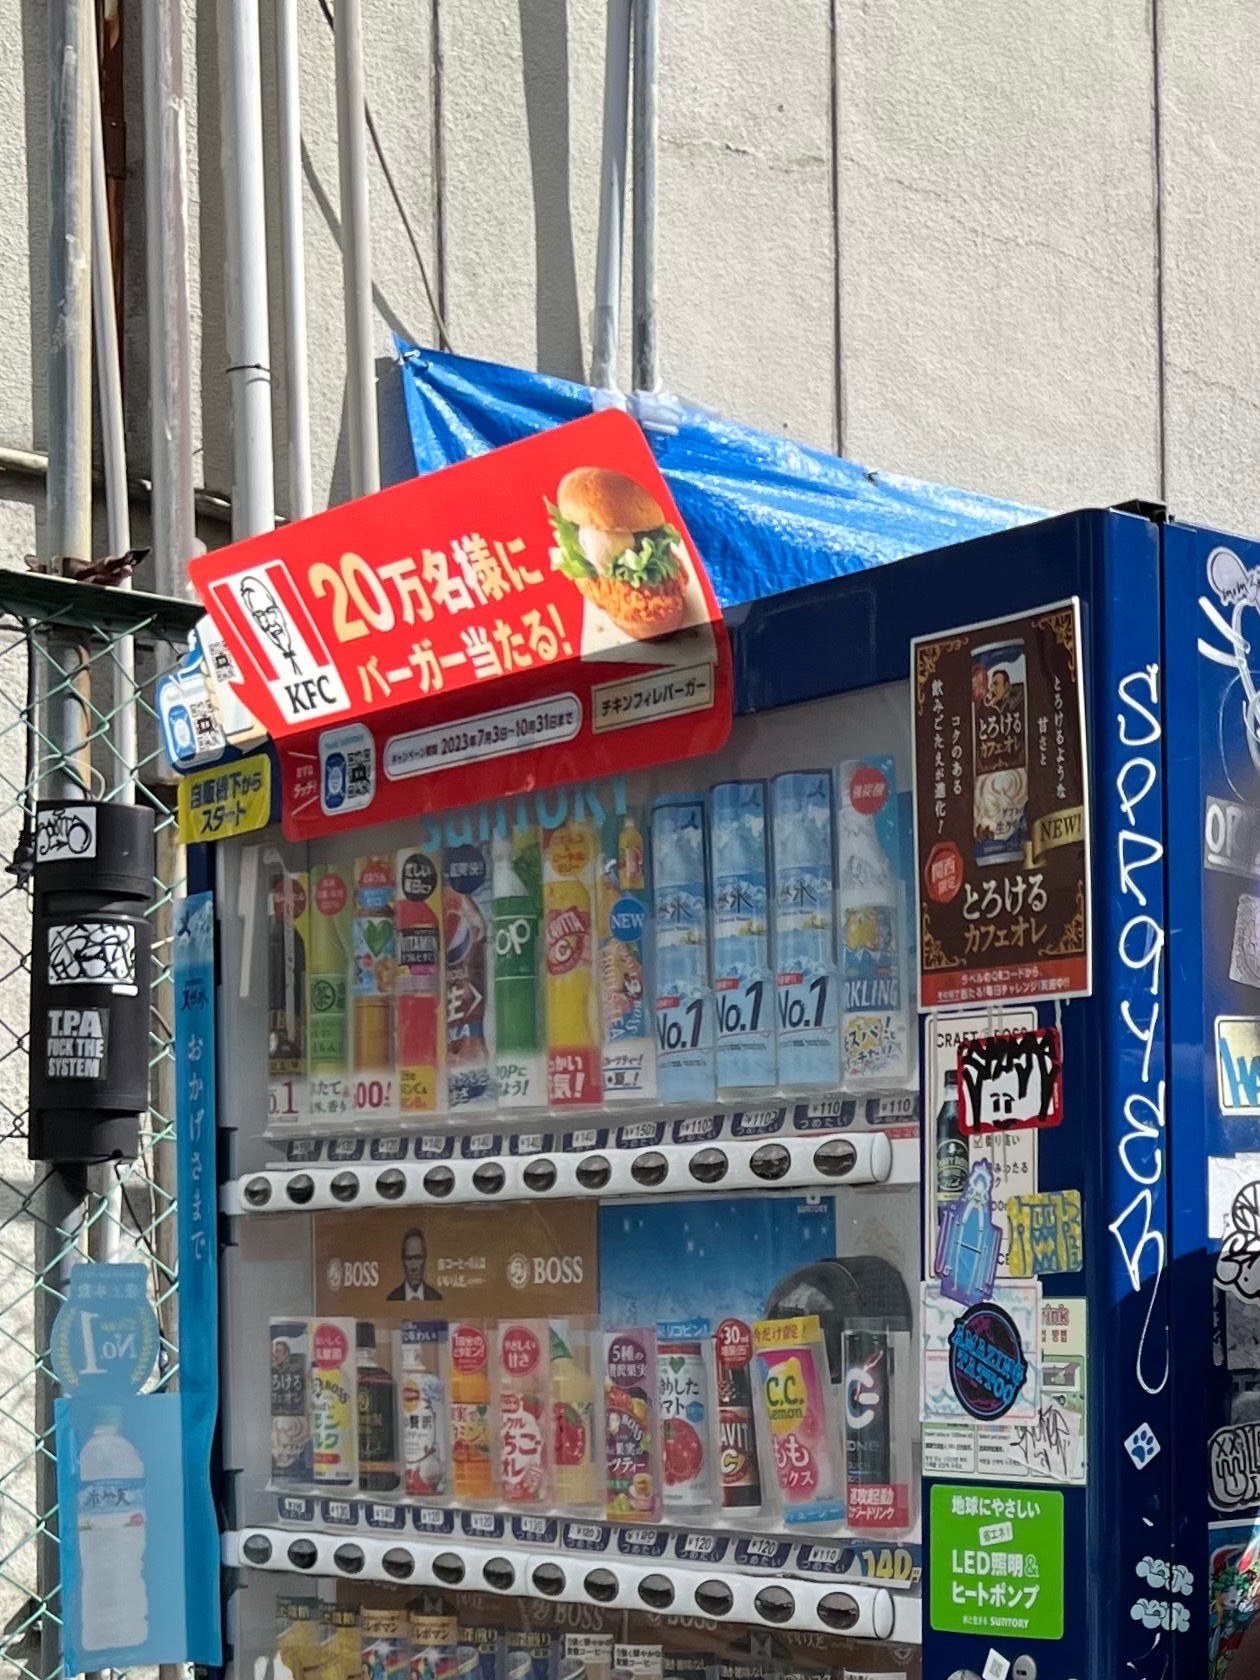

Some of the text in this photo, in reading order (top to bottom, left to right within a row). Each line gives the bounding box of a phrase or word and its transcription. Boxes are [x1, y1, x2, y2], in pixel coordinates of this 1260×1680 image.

[308, 532, 543, 643] 20万名様に
[284, 674, 337, 714] KFC
[600, 679, 708, 717] チキンフィレバーガー
[978, 712, 1023, 739] とろける
[950, 715, 963, 796] コクのある
[201, 802, 248, 835] スタート
[1039, 809, 1082, 844] NEW!
[930, 856, 956, 884] 関西
[962, 871, 1049, 921] とろける
[610, 911, 645, 930] NEW
[963, 916, 1048, 956] カフェオレ
[47, 1009, 103, 1038] T.P.A
[75, 1038, 105, 1060] THE
[48, 1057, 100, 1079] SYSTEM
[881, 1098, 911, 1113] ¥110
[343, 1260, 380, 1288] BOSS
[533, 1255, 584, 1285] BOSS
[951, 1324, 1026, 1386] AMAZING
[271, 1373, 304, 1391] ろける
[956, 1350, 1017, 1404] TATTOO
[766, 1376, 805, 1407] C.C.
[951, 1495, 1041, 1521] 地球にやさしい
[687, 1535, 712, 1551] ¥120
[750, 1539, 776, 1556] ¥120
[813, 1549, 838, 1562] ¥110
[951, 1581, 1041, 1610] ヒートポンプ
[553, 1606, 605, 1632] BOSS
[989, 1615, 1030, 1630] SUNTORY
